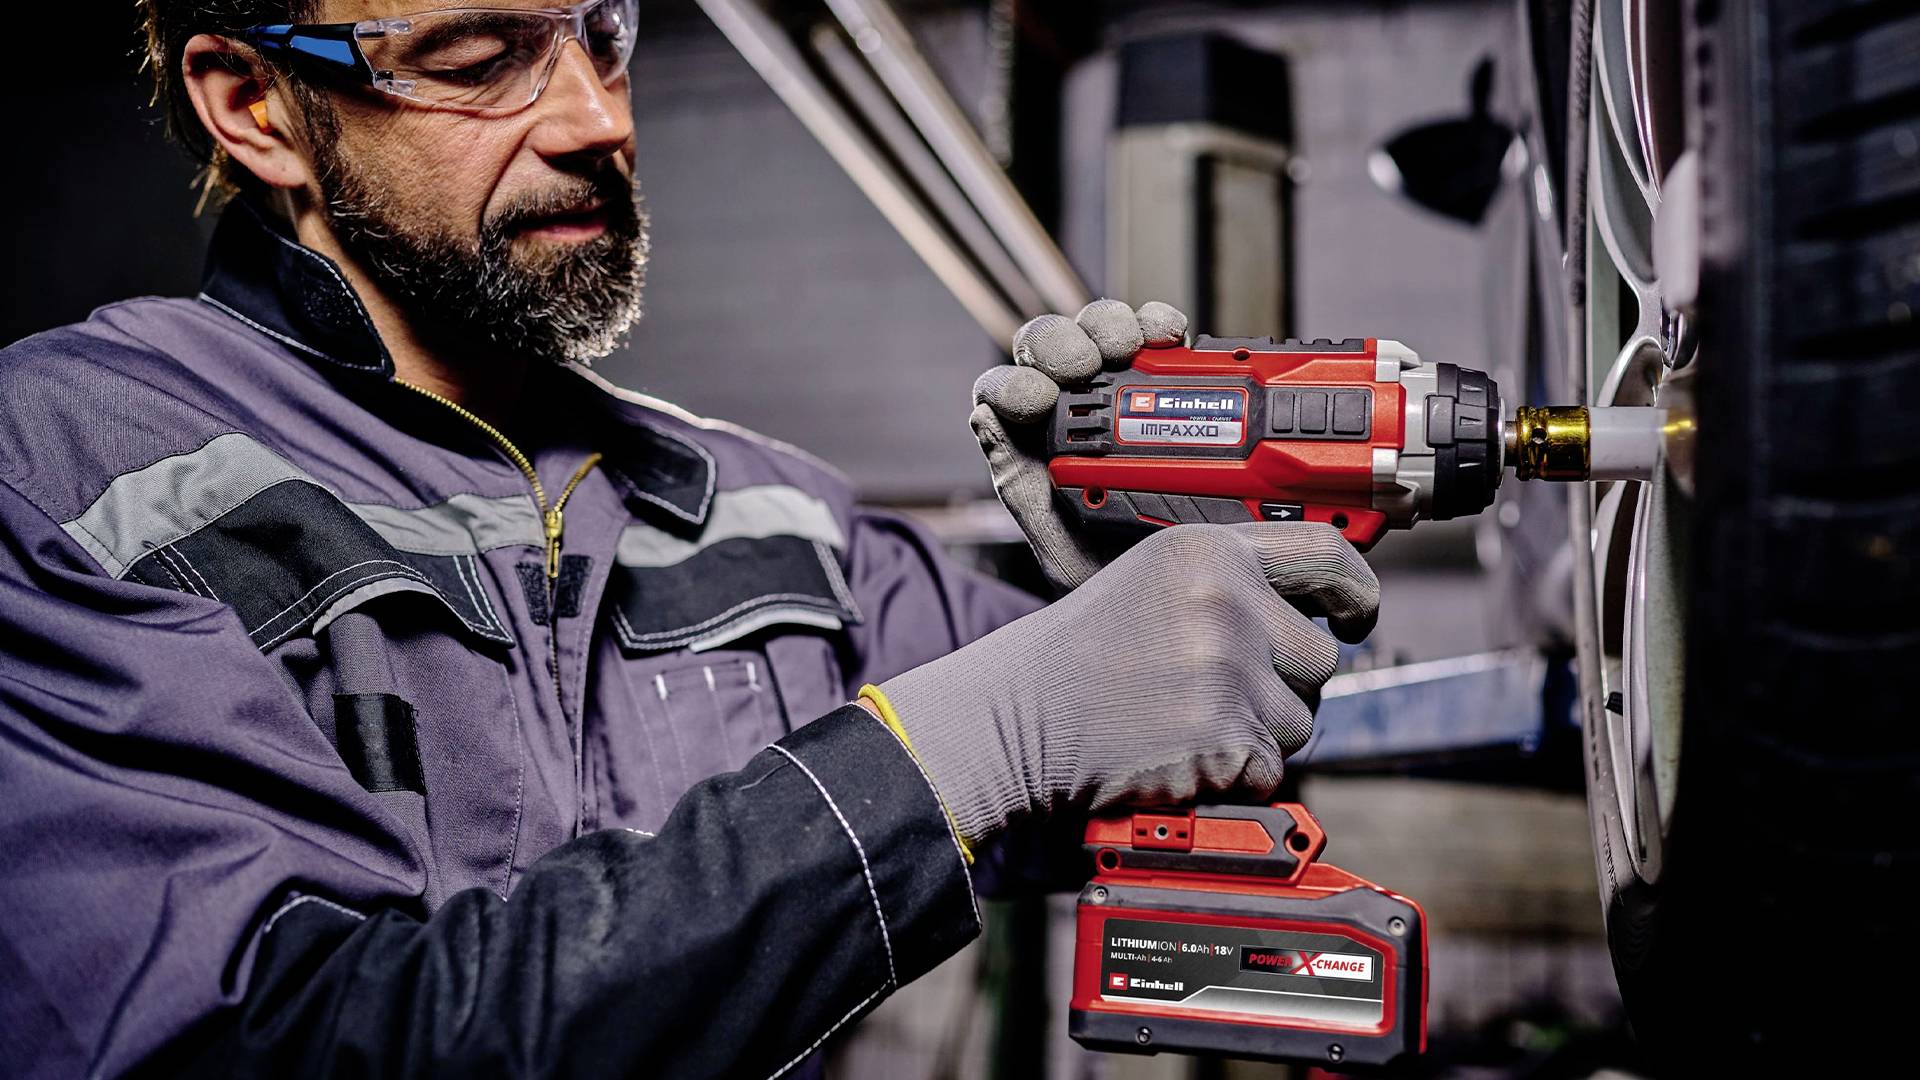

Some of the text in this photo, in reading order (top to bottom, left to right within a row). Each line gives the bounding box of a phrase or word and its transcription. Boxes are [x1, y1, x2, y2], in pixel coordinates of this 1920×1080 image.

[1159, 397, 1234, 410] Einhell
[1141, 423, 1219, 437] IMPAXXO
[1248, 954, 1293, 967] POWER
[1130, 978, 1184, 992] Einhell
